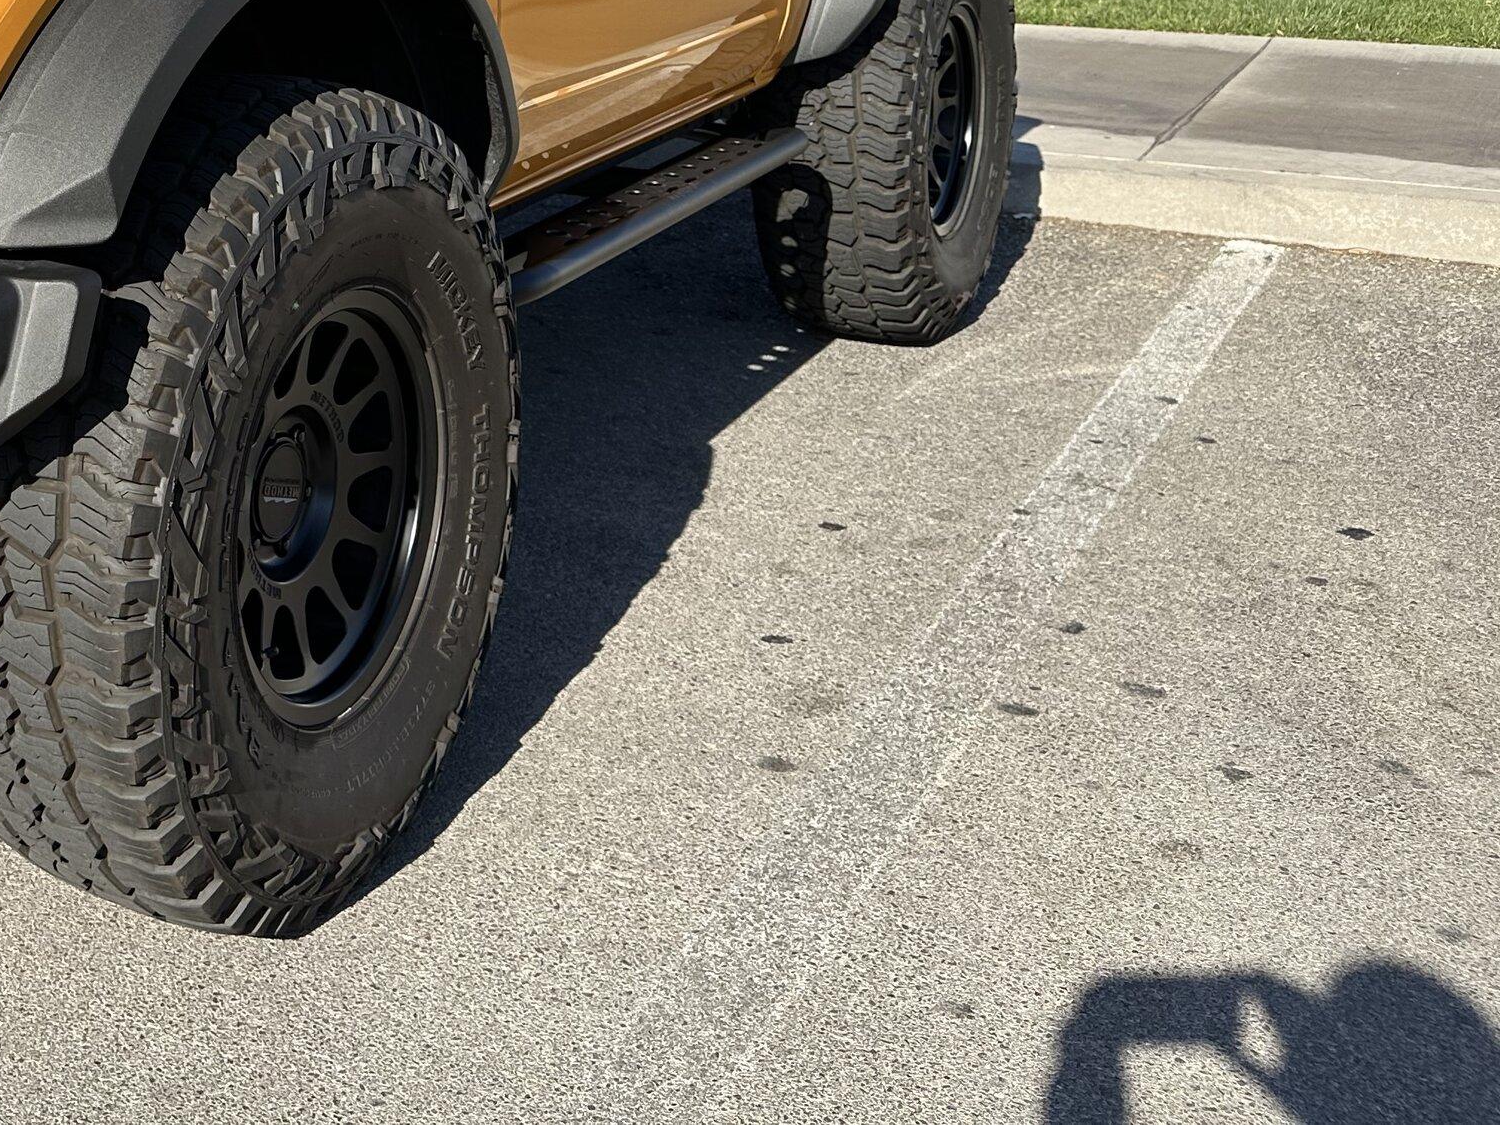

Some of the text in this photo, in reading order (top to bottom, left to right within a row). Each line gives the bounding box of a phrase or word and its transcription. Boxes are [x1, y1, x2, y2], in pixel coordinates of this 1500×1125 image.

[309, 389, 346, 444] METHOD
[426, 249, 492, 659] MICKEY THOMPSON
[263, 484, 301, 497] METHOD
